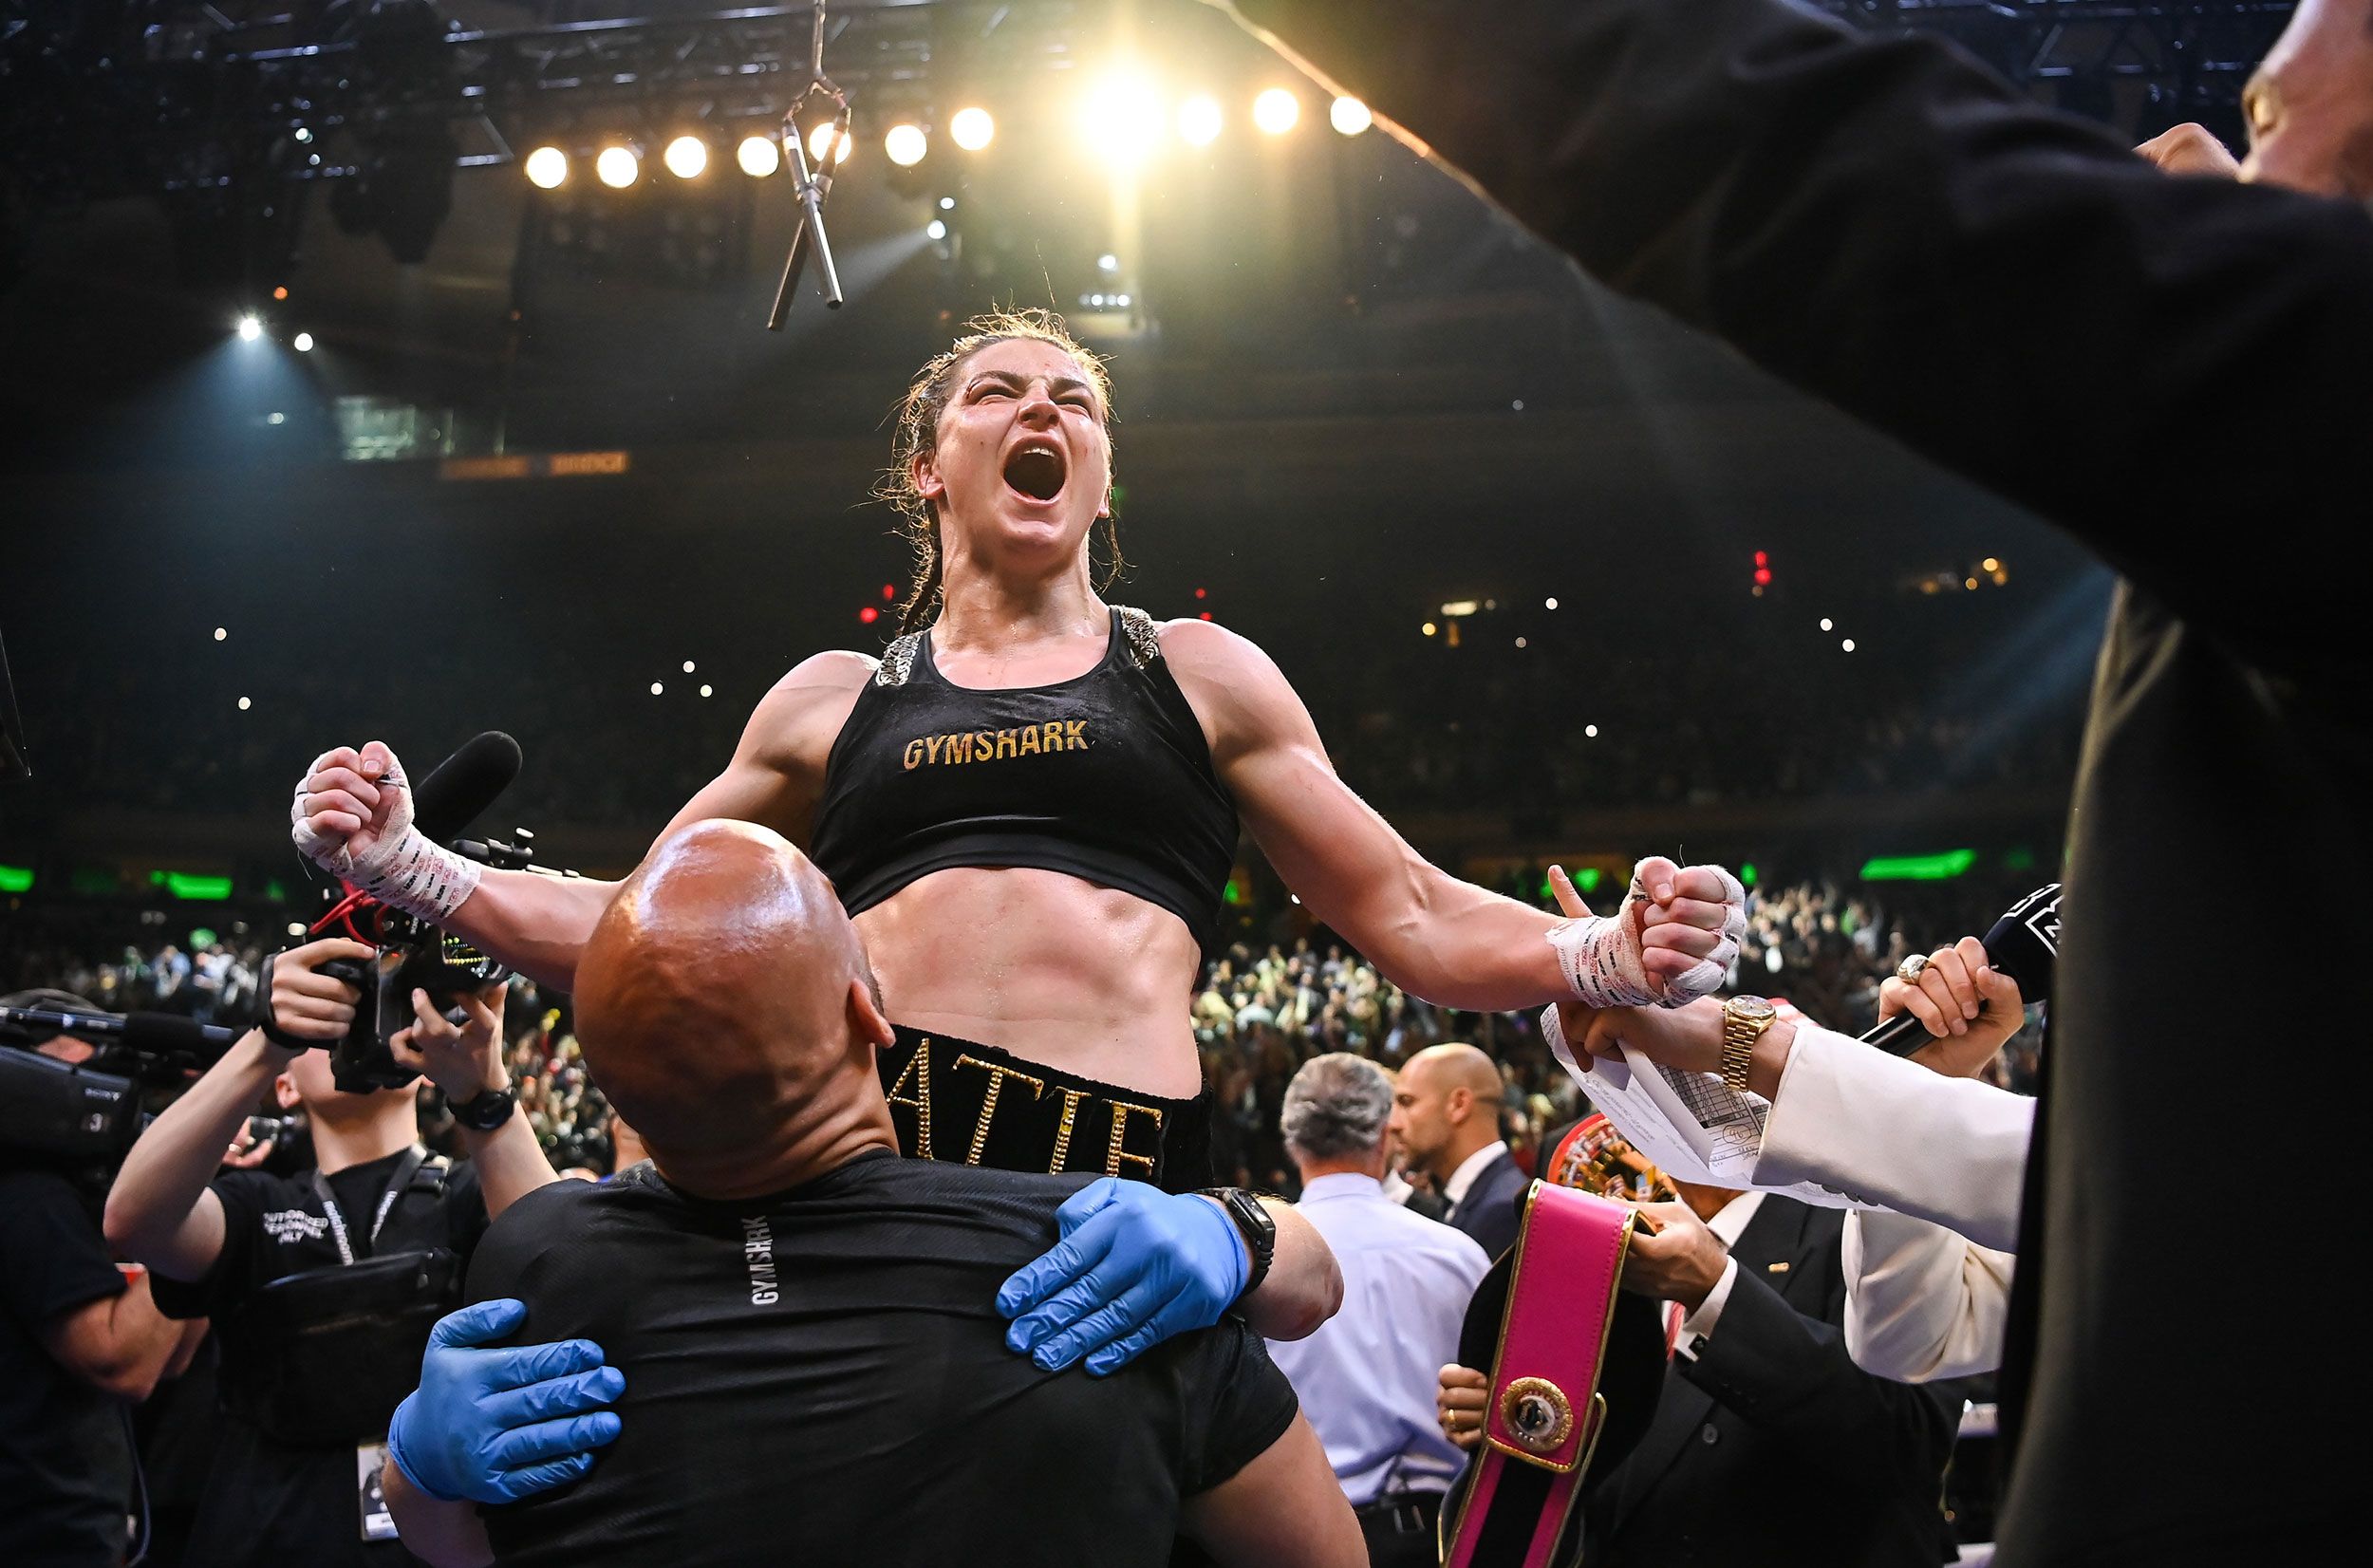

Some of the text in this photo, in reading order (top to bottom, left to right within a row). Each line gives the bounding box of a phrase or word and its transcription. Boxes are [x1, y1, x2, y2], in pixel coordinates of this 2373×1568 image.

[904, 719, 1090, 771] GYMSHARK
[886, 1037, 1162, 1178] ATIE
[741, 1215, 779, 1305] GYMSHRK
